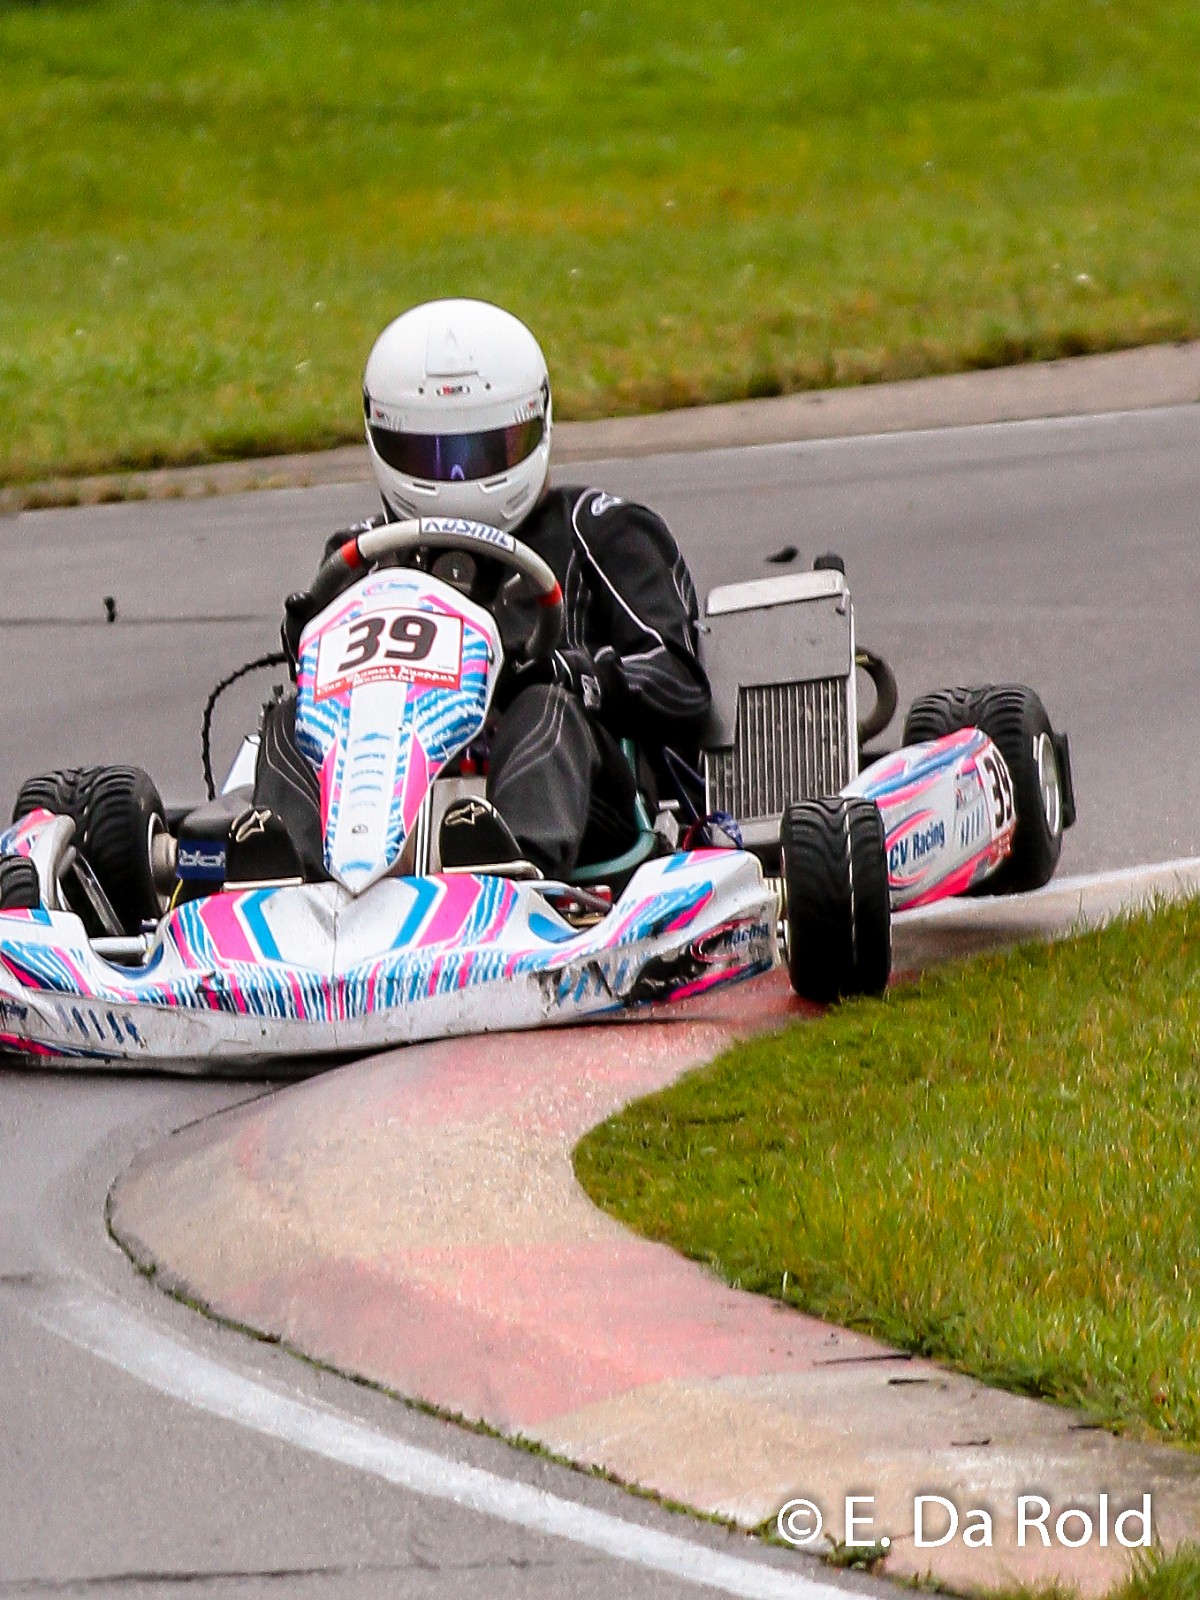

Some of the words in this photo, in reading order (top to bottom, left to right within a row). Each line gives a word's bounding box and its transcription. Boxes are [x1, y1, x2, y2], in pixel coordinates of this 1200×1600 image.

[337, 614, 438, 673] 39
[889, 838, 909, 871] CV
[912, 820, 945, 861] Racing
